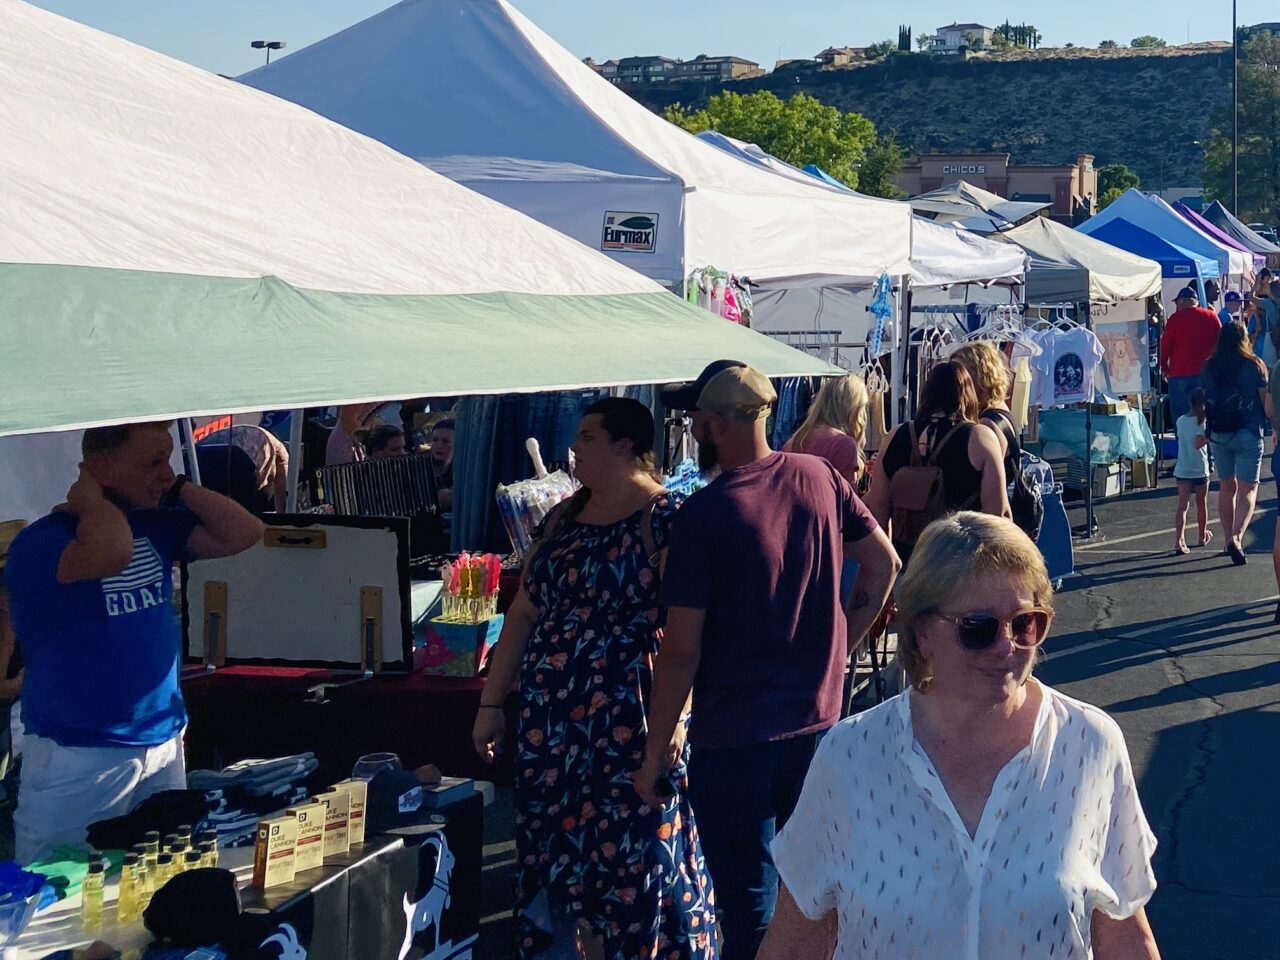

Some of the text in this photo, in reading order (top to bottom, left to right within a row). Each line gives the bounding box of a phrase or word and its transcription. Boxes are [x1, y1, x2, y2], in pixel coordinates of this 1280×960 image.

[943, 165, 985, 174] CHICO'S
[603, 226, 652, 245] Eurmax
[270, 834, 286, 843] DUKE
[269, 839, 295, 850] CANNON
